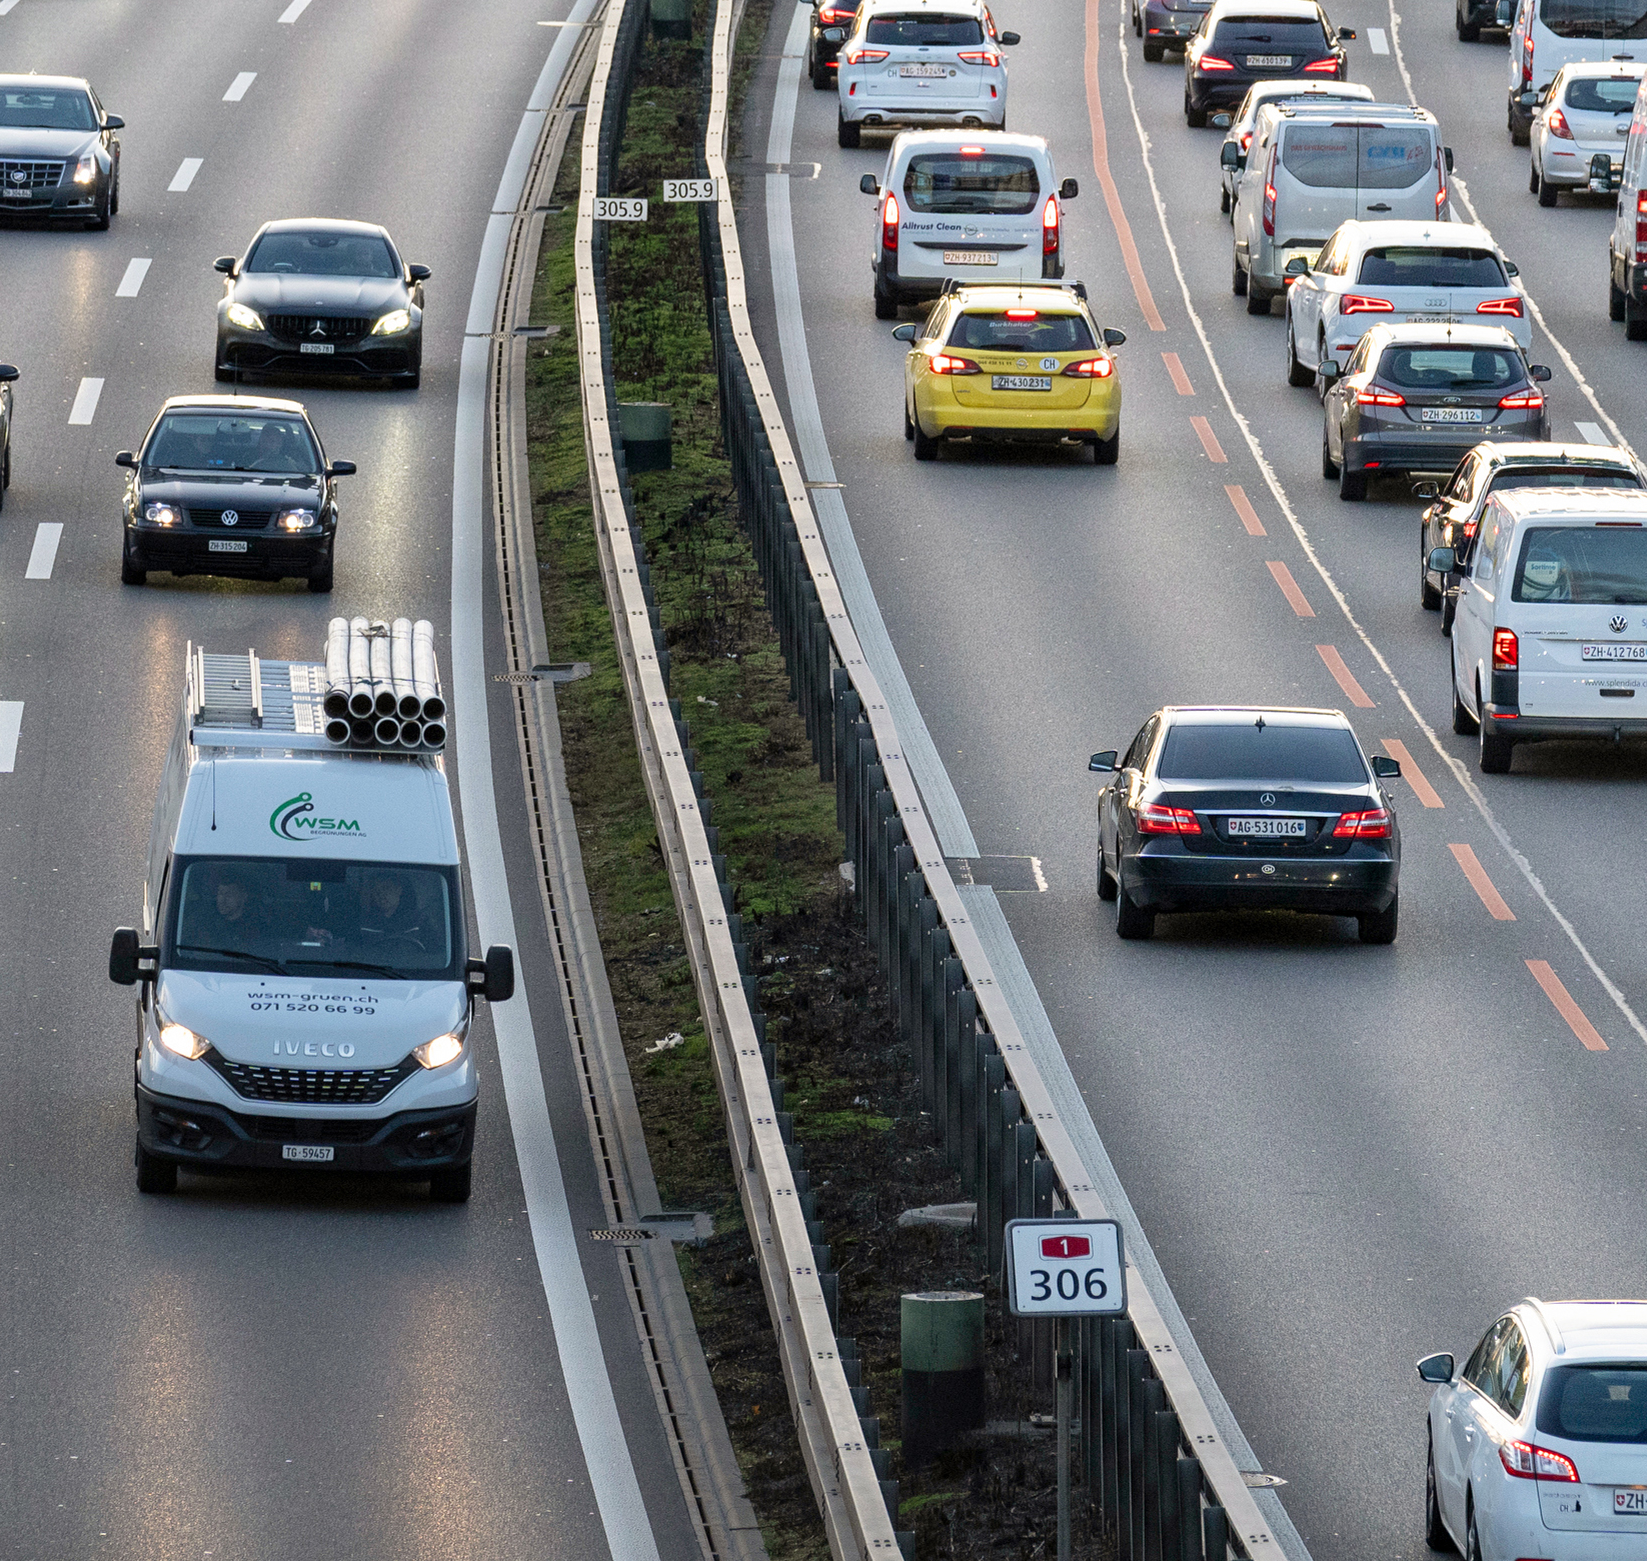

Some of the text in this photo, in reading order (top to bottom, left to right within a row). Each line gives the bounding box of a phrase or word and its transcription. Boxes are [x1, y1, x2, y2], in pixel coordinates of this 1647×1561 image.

[888, 70, 898, 78] CH
[667, 182, 714, 199] 305.9
[597, 200, 644, 217] 305.9
[901, 222, 962, 231] Alltrust Clean
[1043, 359, 1056, 369] CH
[293, 817, 361, 831] WSM
[247, 991, 379, 1004] wsm-gruen.ch
[250, 1002, 376, 1016] 071 520 66 99
[272, 1039, 355, 1058] IVECO
[1059, 1239, 1069, 1255] 1
[1029, 1267, 1108, 1302] 306
